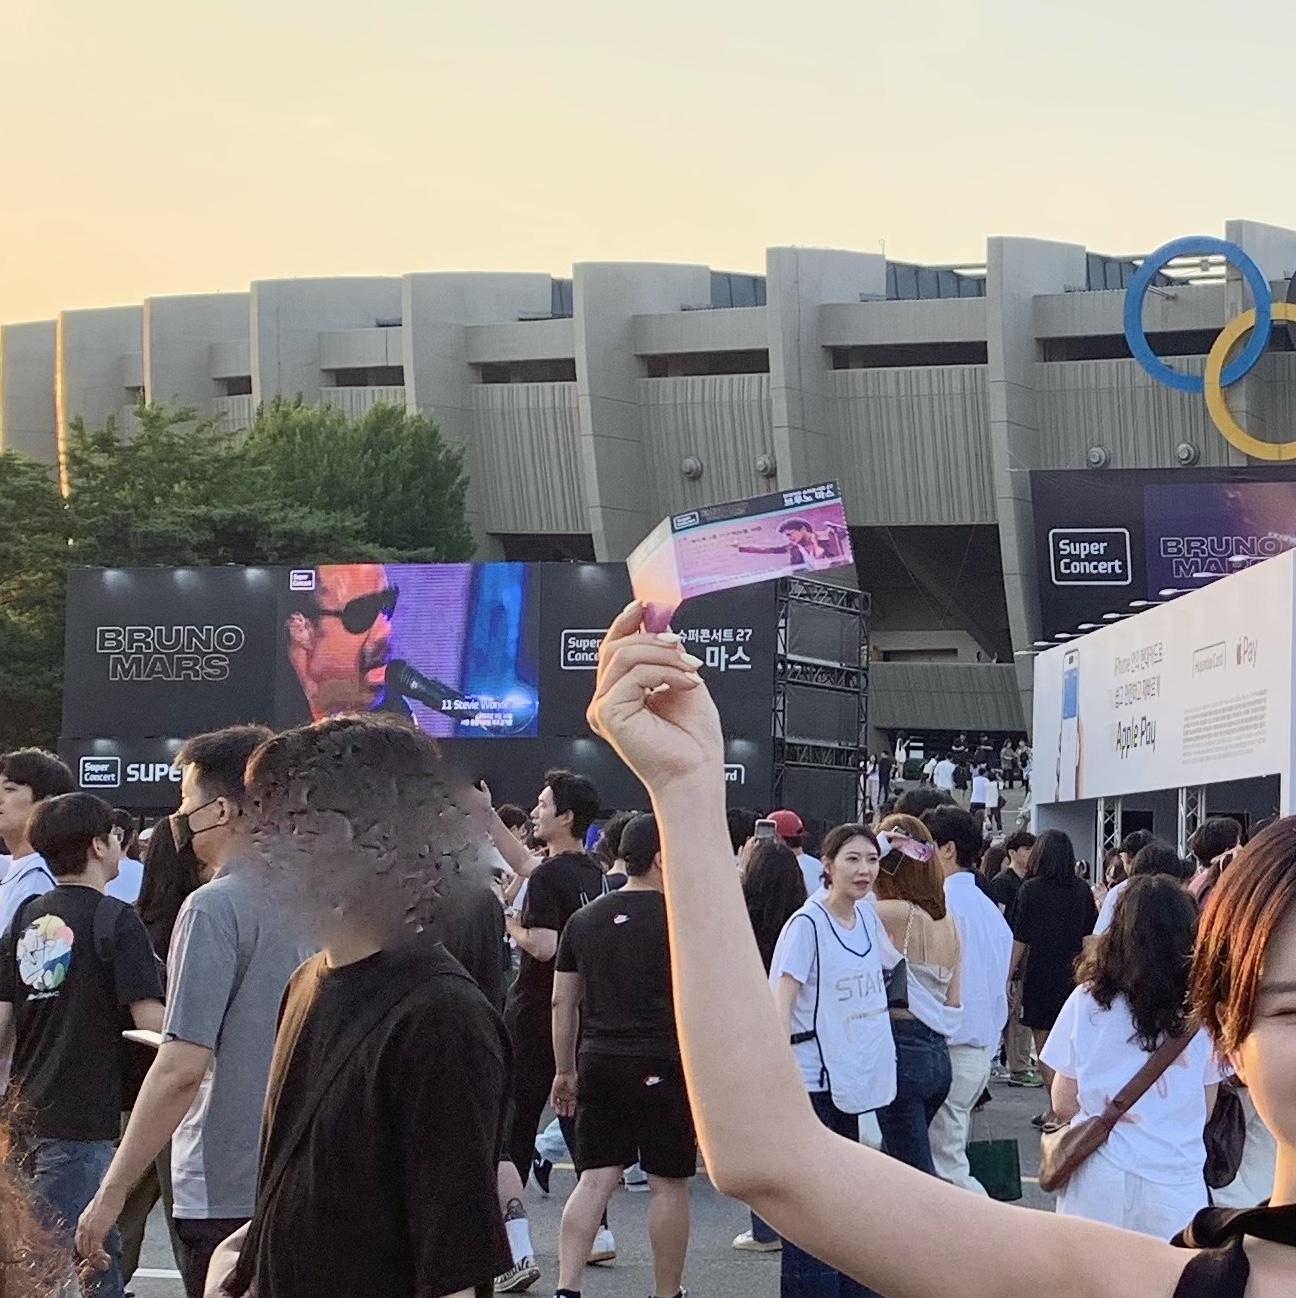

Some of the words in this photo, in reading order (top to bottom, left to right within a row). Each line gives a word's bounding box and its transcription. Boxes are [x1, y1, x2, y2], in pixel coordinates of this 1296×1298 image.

[1058, 539, 1108, 558] Super
[1160, 535, 1283, 558] BRUNO
[1060, 558, 1123, 575] Concert
[96, 625, 245, 653] BRUNO
[736, 628, 753, 642] 27
[567, 650, 600, 662] Conce
[705, 645, 752, 672] 마스
[1242, 635, 1258, 668] Pay
[109, 654, 230, 681] MARS
[453, 699, 480, 710] Stevie
[1115, 715, 1138, 760] Apple
[1139, 715, 1157, 754] Pay
[84, 761, 110, 773] Super
[126, 762, 182, 783] SUPE
[84, 773, 117, 783] Concert
